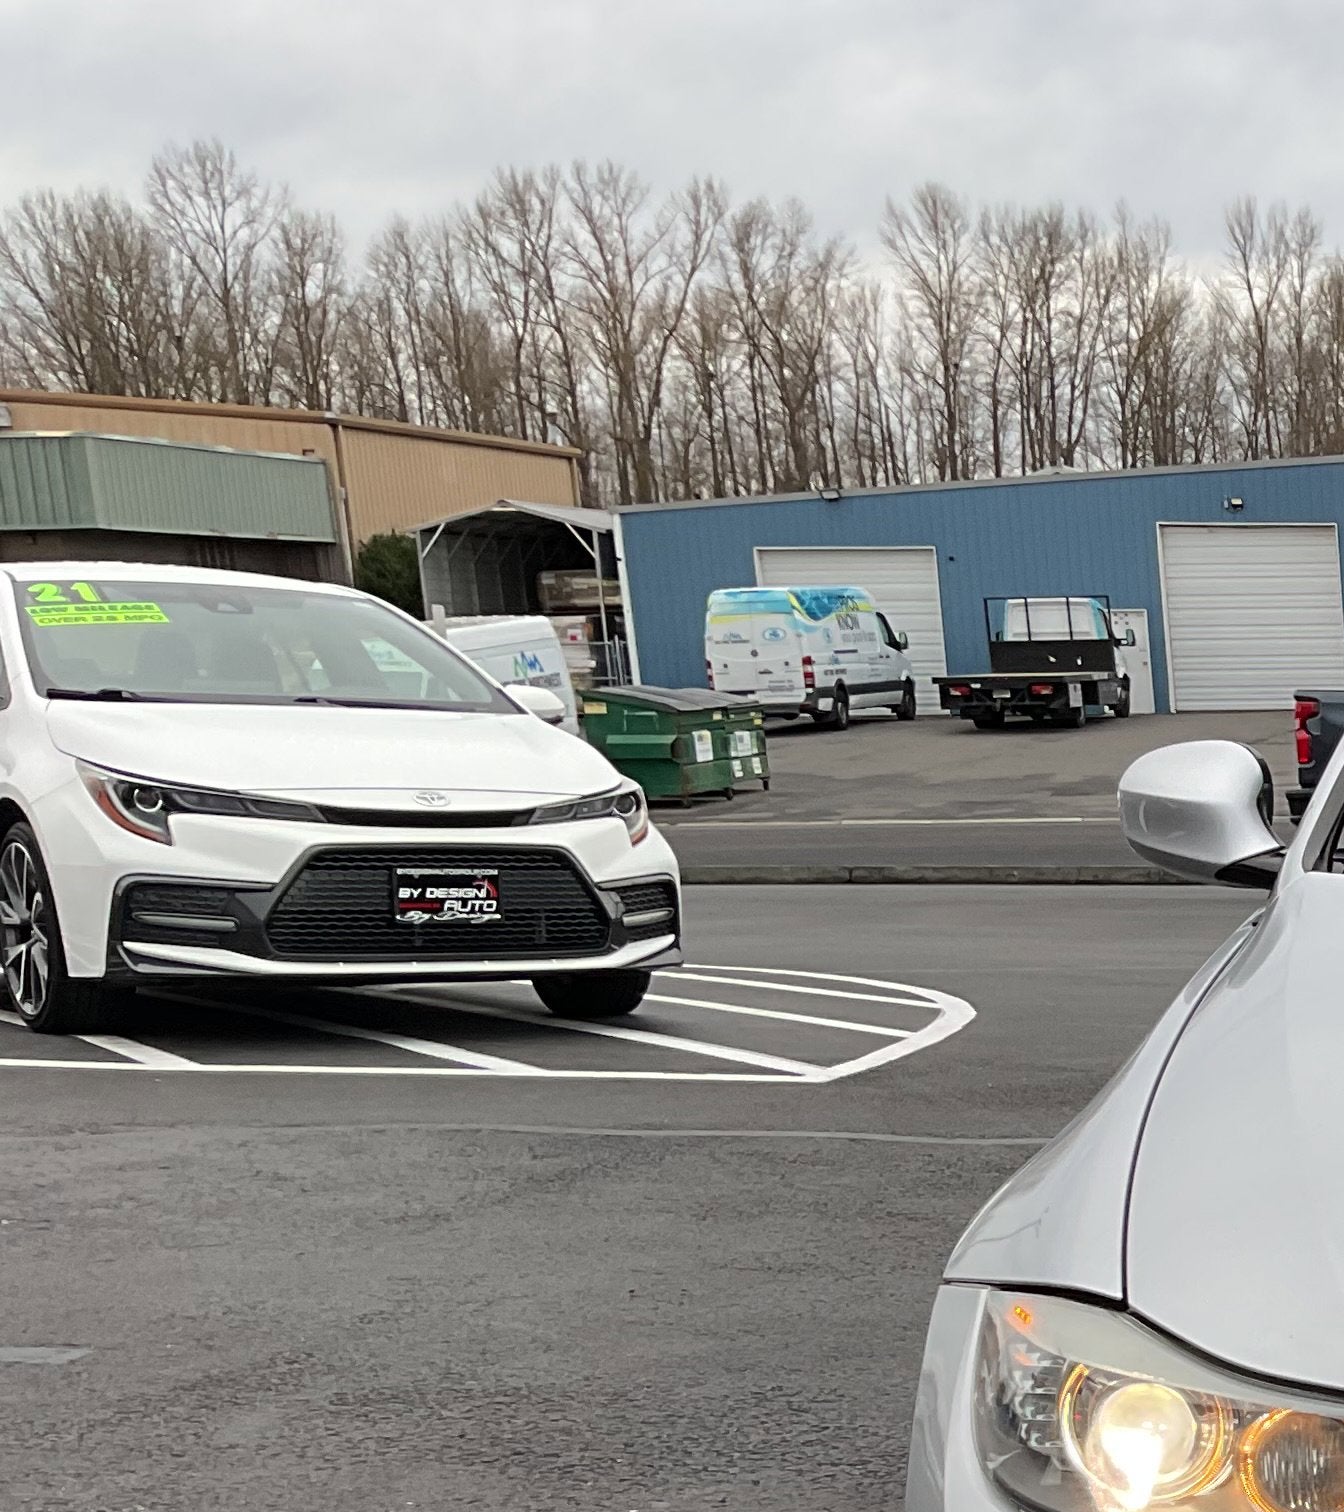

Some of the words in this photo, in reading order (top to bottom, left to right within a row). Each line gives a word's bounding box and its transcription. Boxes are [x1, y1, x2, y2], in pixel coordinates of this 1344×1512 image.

[26, 582, 100, 602] 21
[398, 888, 422, 898] BY
[425, 888, 486, 898] DESIGN
[444, 900, 497, 911] AUTO
